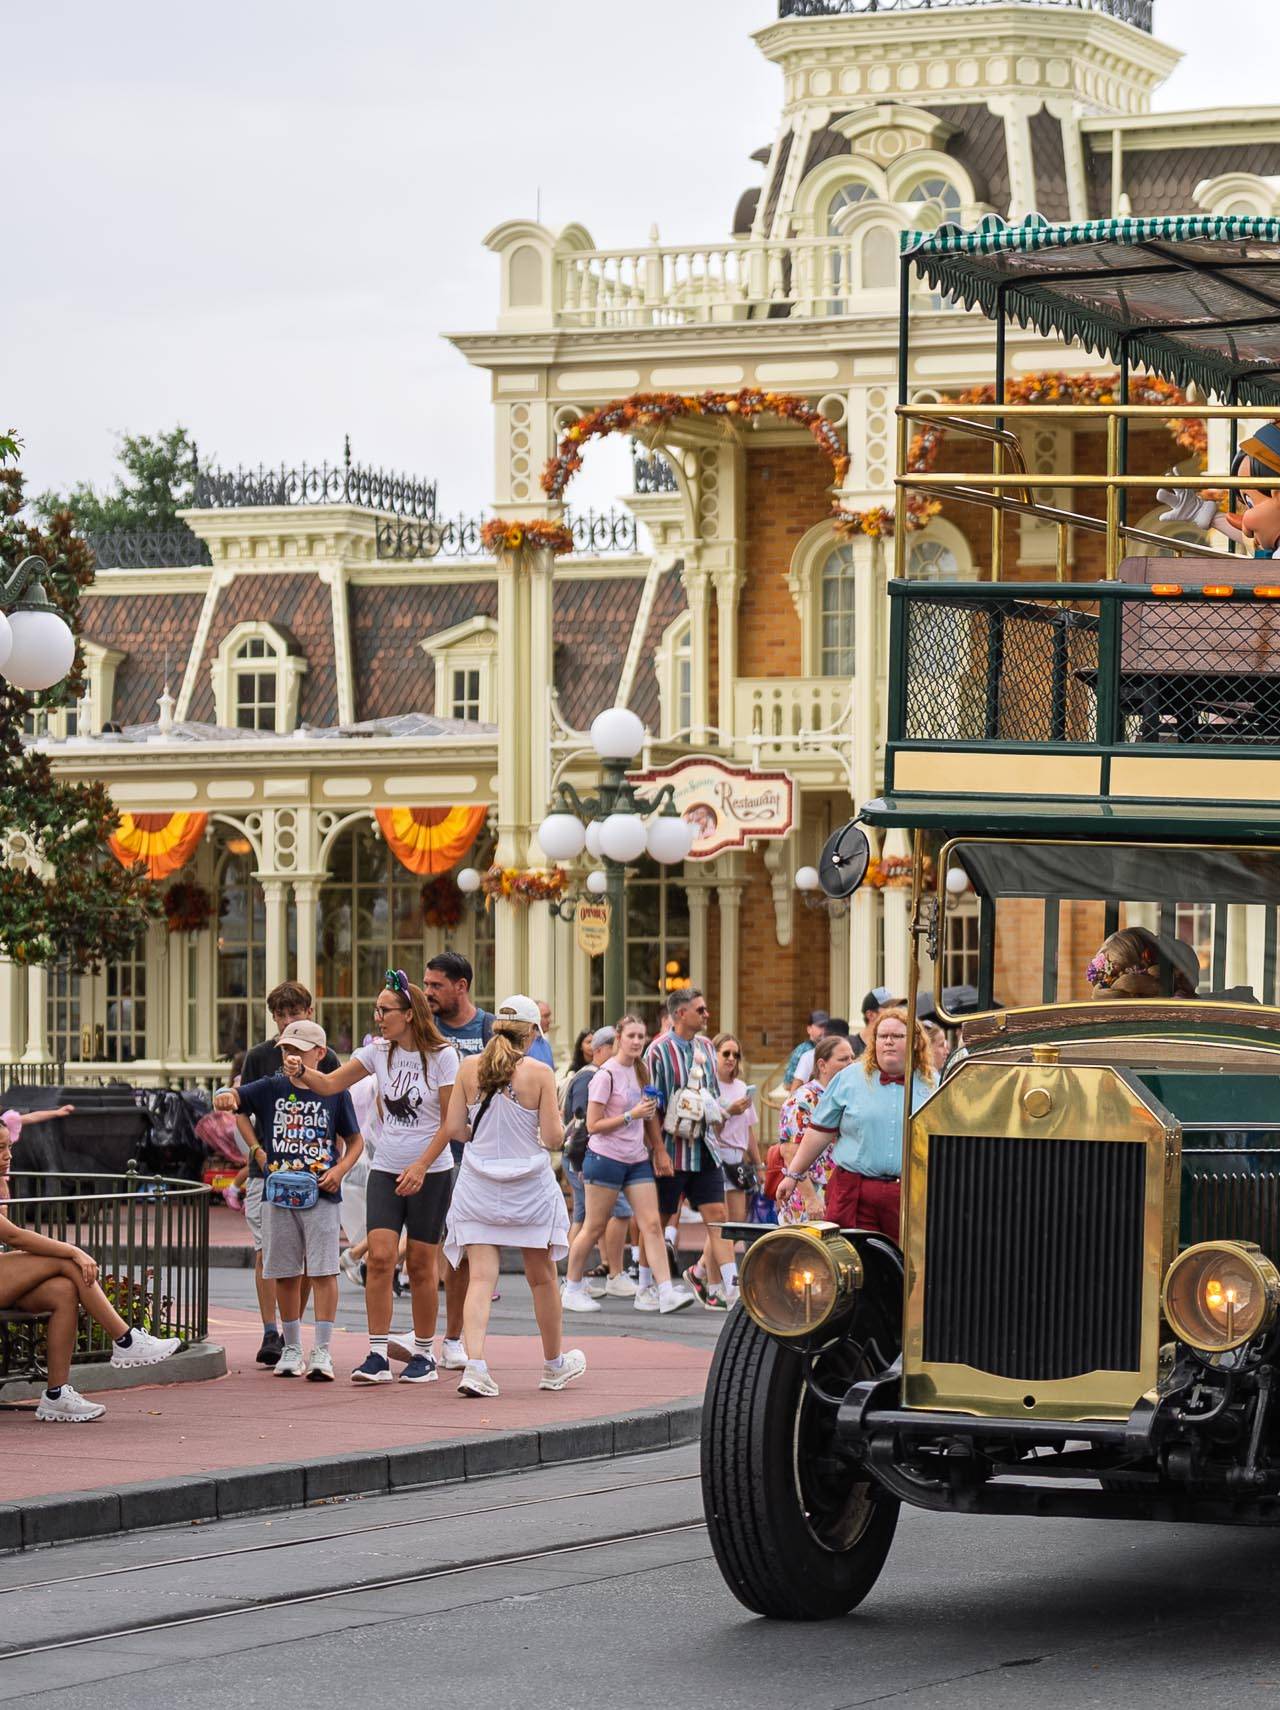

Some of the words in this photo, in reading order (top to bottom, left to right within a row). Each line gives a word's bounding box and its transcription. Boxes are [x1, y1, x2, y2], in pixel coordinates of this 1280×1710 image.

[713, 781, 781, 822] Restaurant
[274, 1097, 322, 1114] Goofy
[273, 1108, 328, 1129] Donald
[273, 1125, 316, 1140] Pluto
